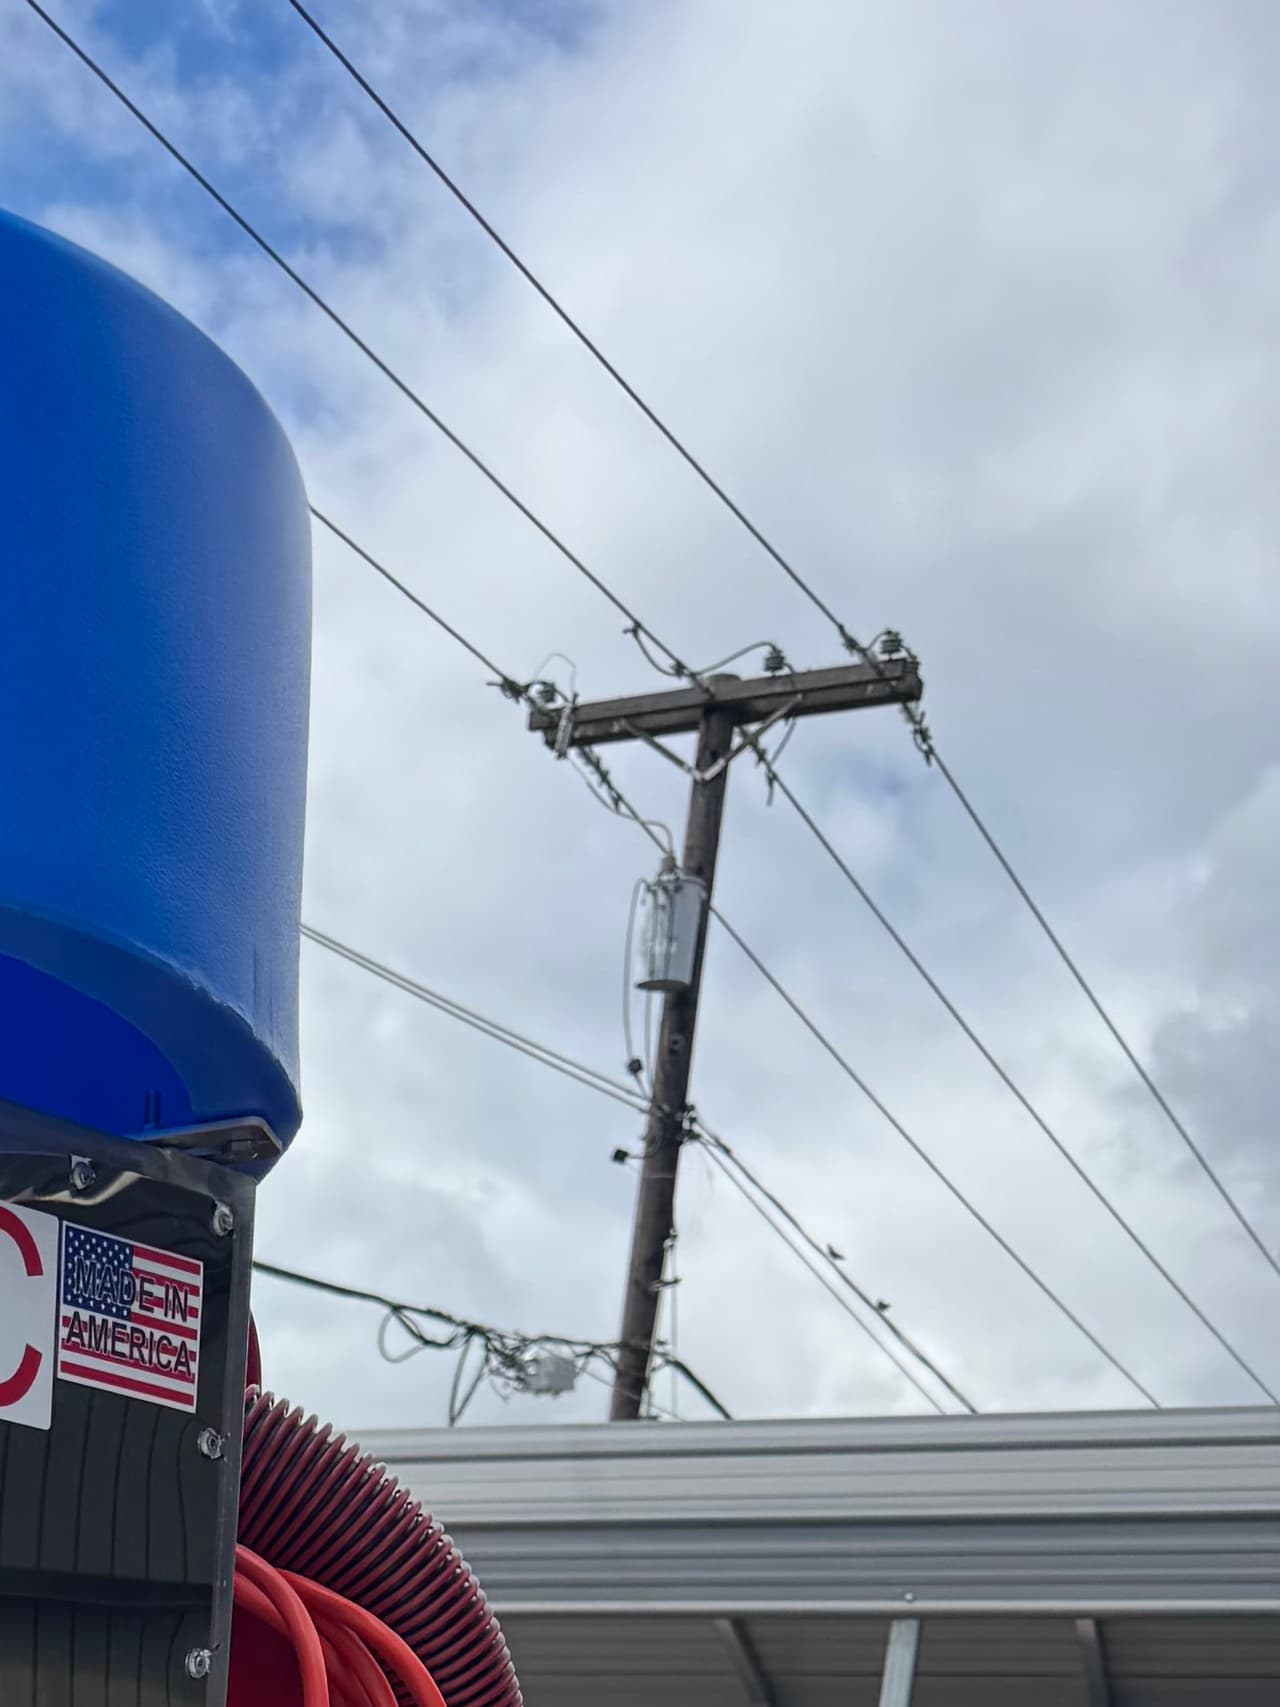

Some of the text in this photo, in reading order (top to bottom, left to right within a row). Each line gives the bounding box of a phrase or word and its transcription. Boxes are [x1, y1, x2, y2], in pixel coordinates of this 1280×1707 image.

[75, 1256, 190, 1322] MADE IN
[65, 1311, 193, 1377] AMERICA
